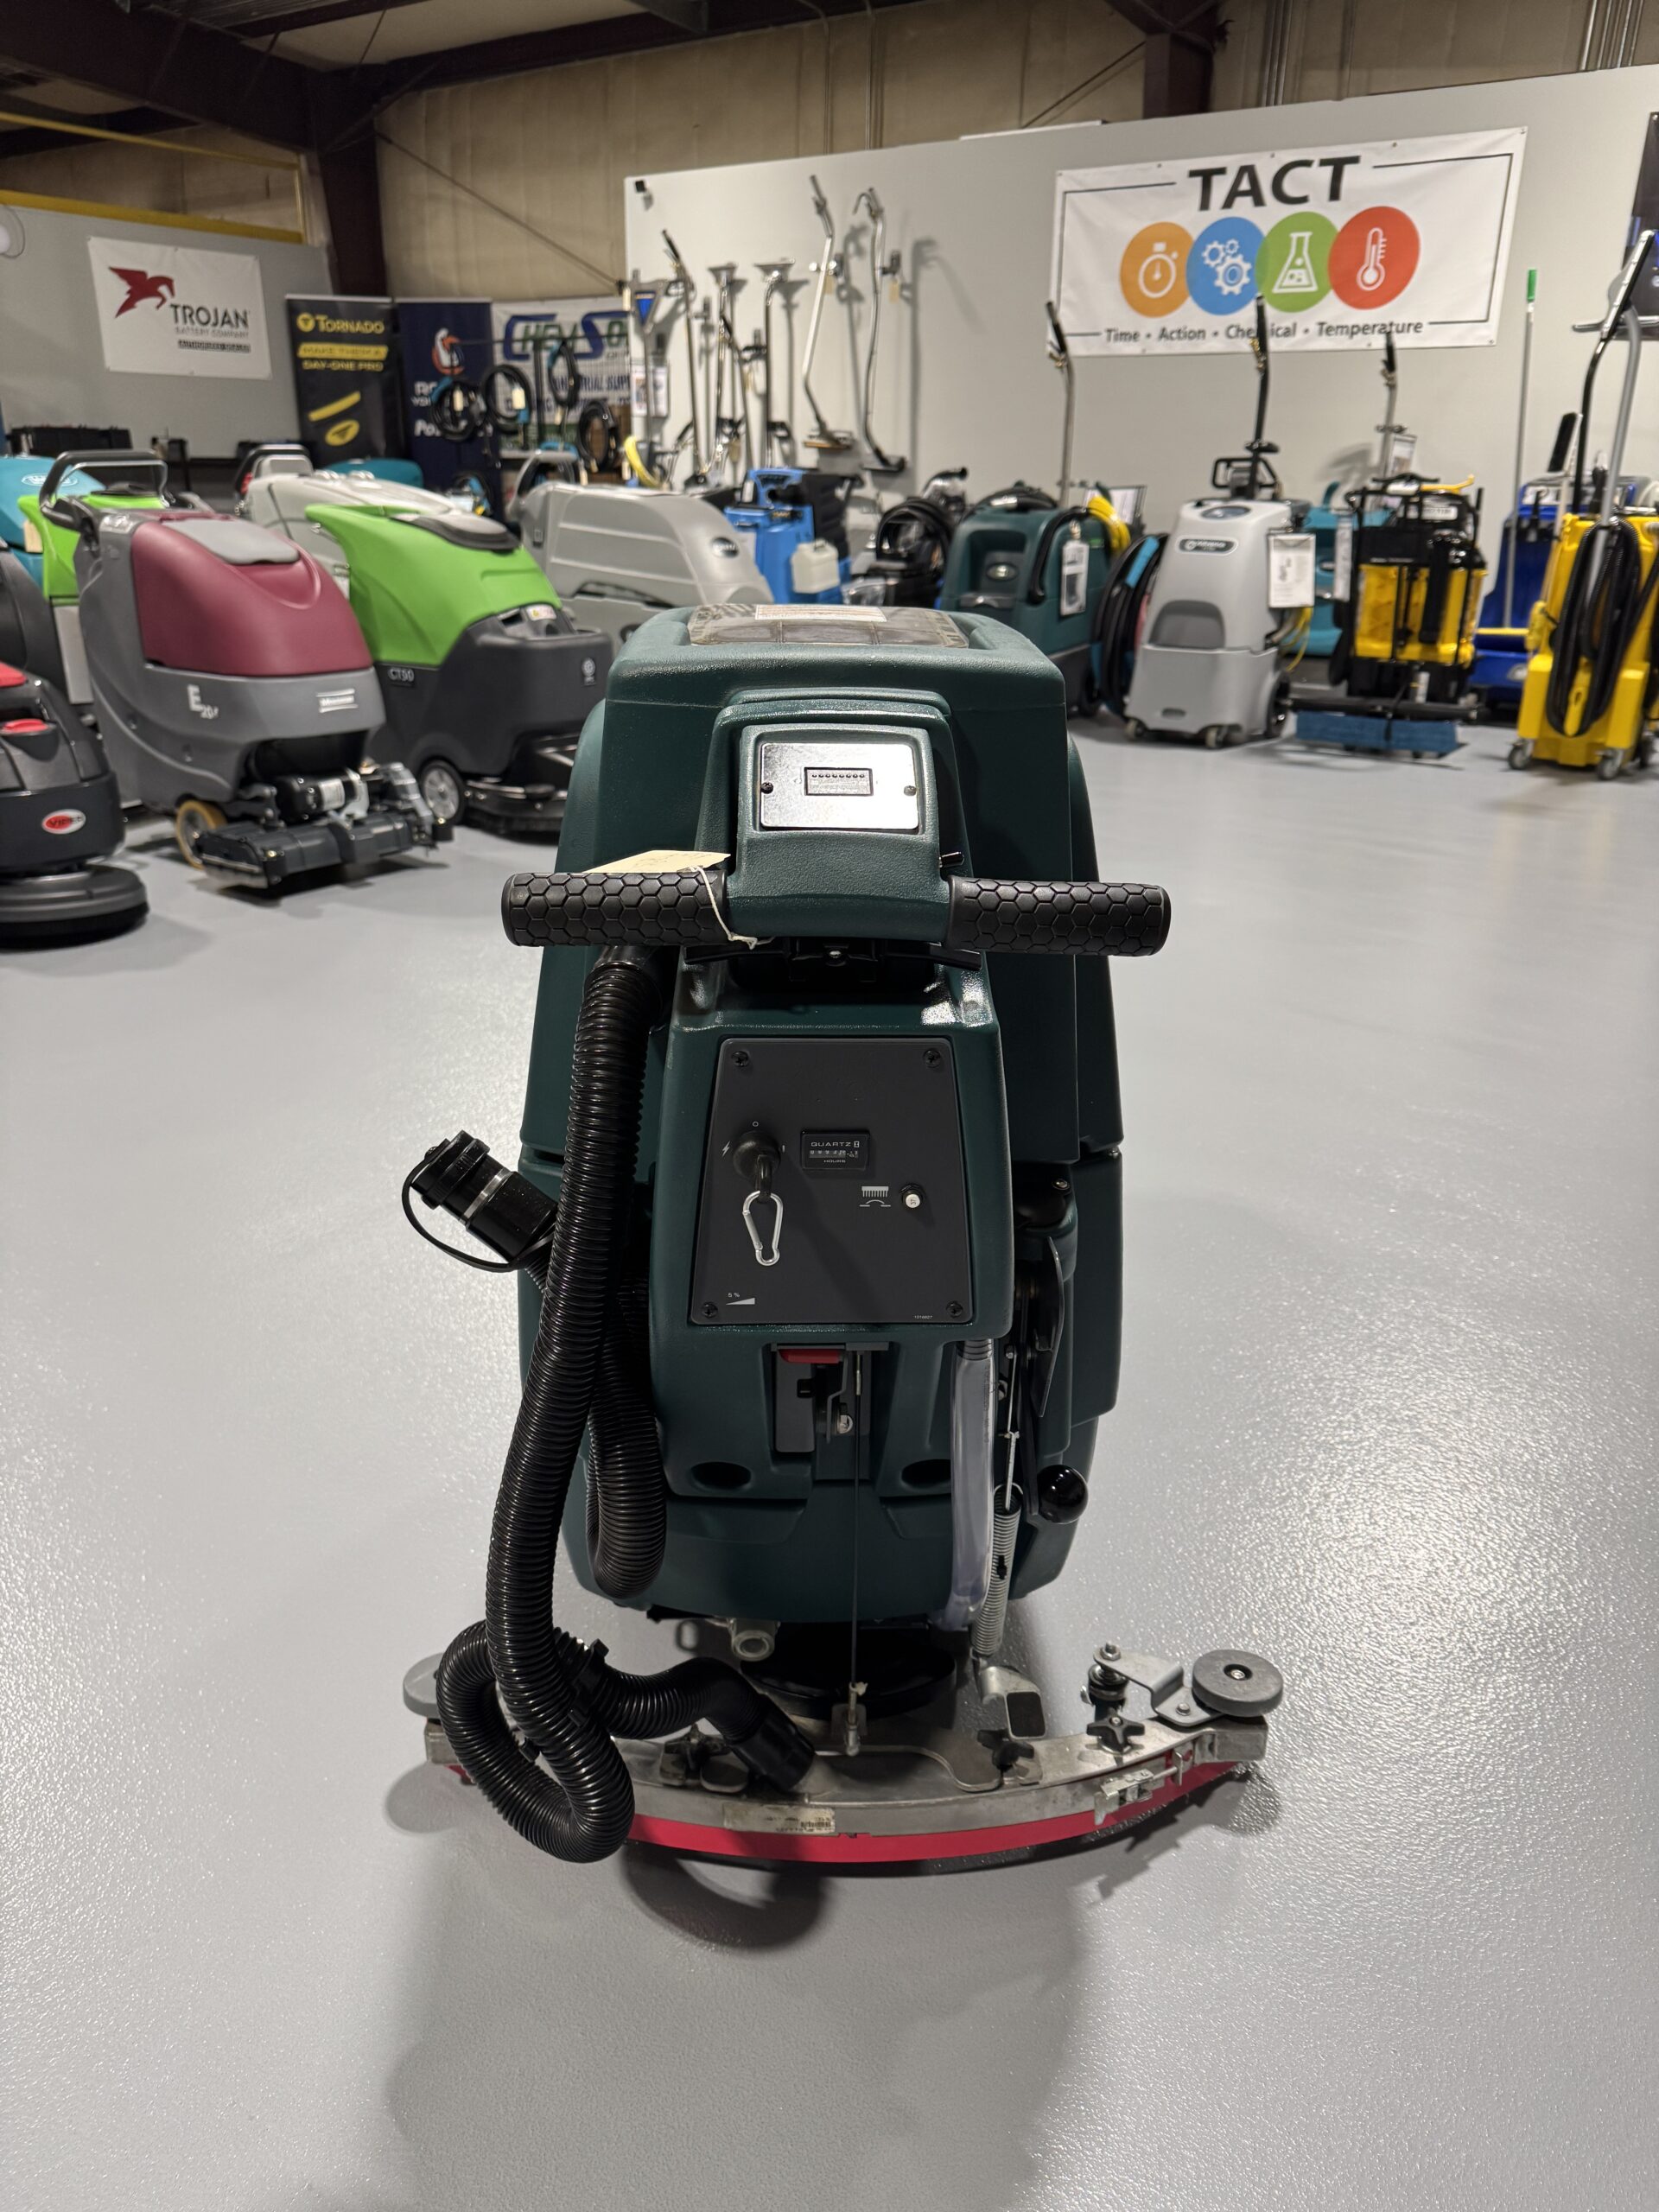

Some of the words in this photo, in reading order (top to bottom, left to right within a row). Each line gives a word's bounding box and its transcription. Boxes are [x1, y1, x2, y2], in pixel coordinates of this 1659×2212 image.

[1188, 156, 1362, 212] TACT
[170, 303, 248, 328] TROJAN
[1105, 327, 1141, 342] Time
[1158, 325, 1206, 341] Action
[1225, 321, 1297, 339] Cheical
[1317, 319, 1424, 340] Temperature
